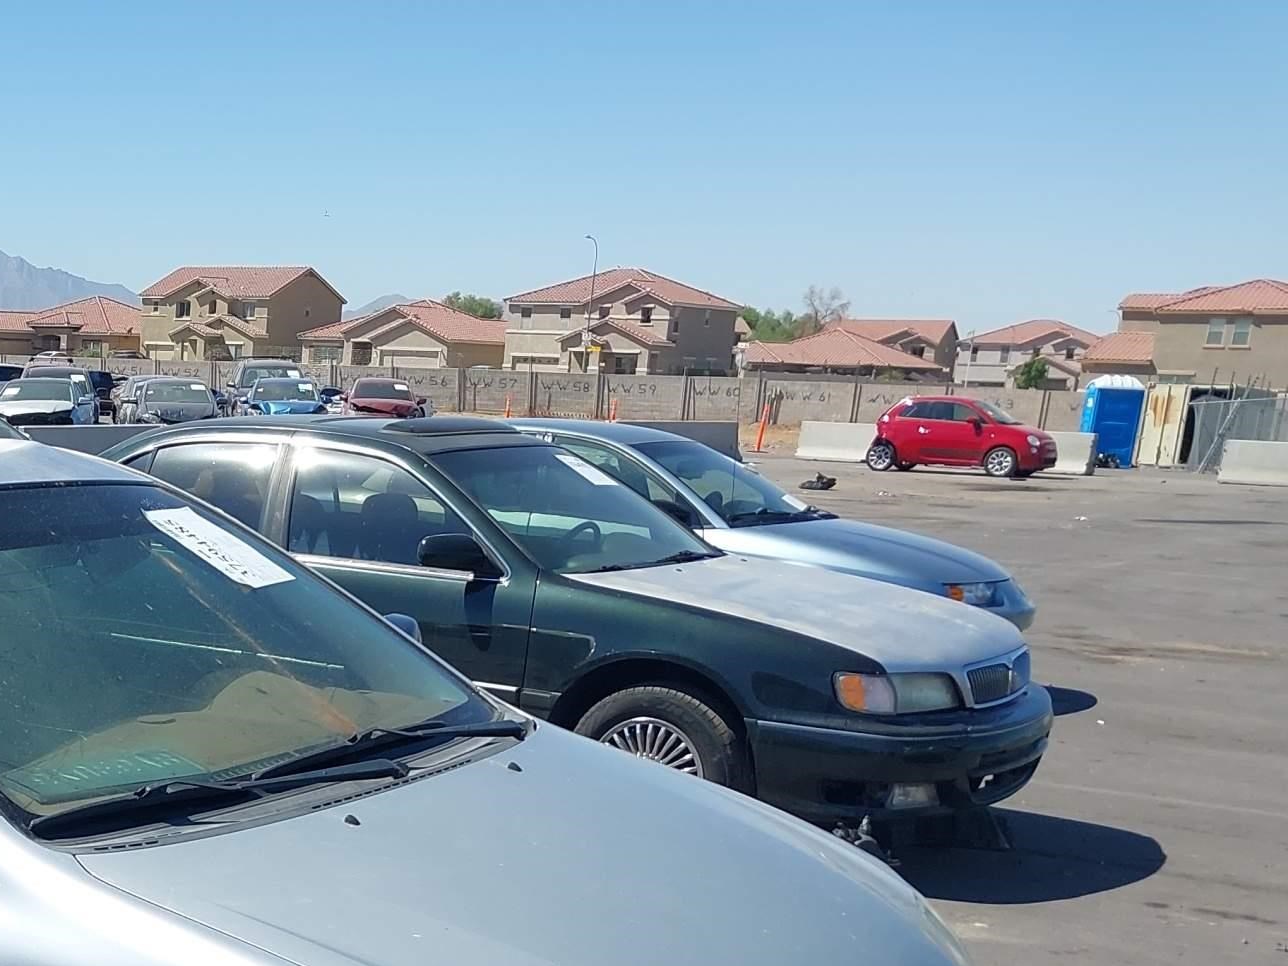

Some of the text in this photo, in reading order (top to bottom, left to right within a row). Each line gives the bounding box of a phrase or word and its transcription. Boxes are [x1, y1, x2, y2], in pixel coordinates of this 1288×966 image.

[429, 376, 448, 387] 56
[499, 378, 518, 389] 57
[573, 380, 591, 393] 58
[638, 383, 657, 394] 59
